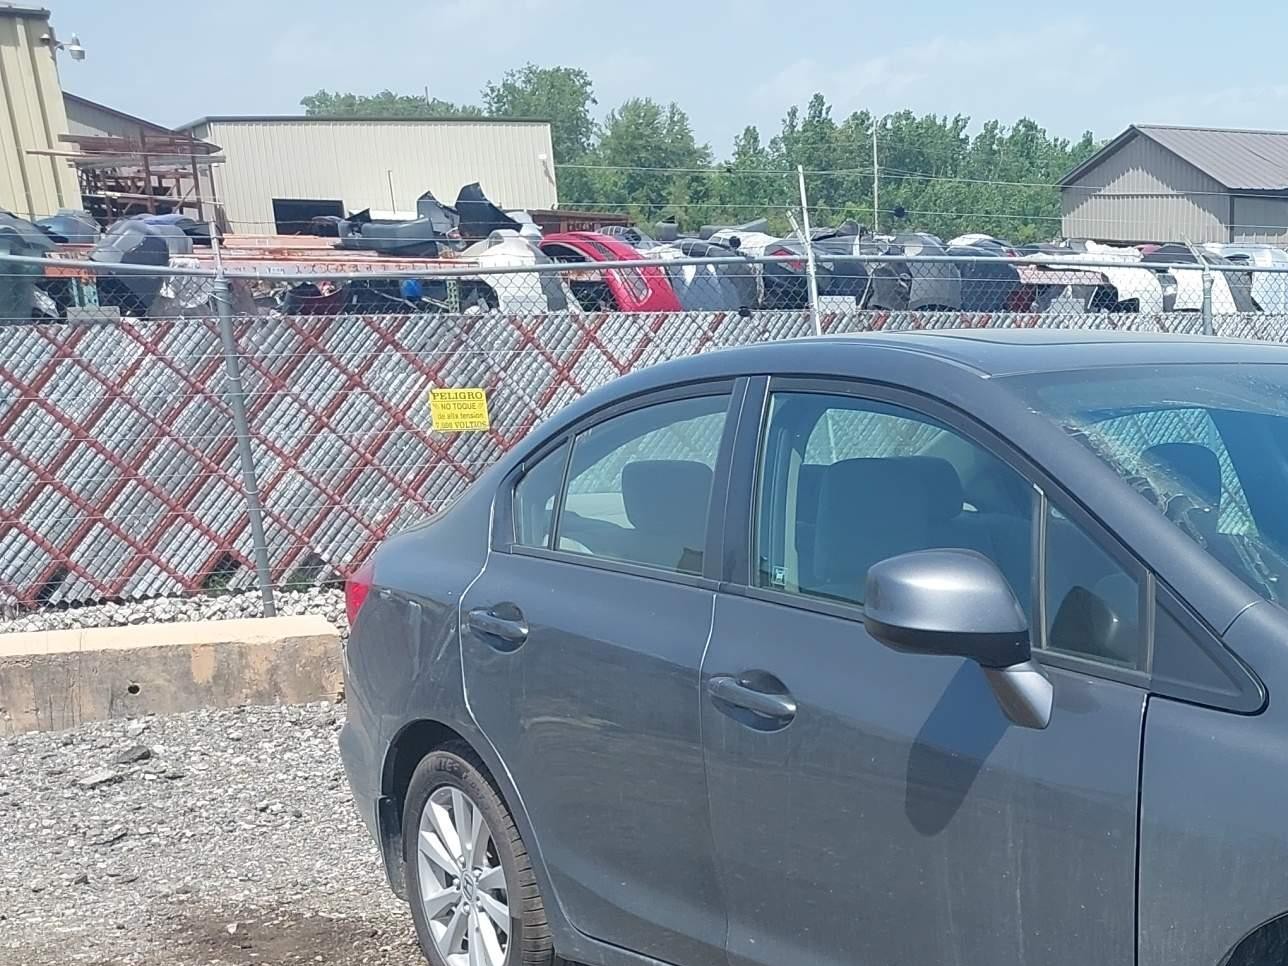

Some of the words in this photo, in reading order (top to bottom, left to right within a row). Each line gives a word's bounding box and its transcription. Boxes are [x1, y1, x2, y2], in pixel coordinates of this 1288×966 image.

[432, 391, 483, 400] PELIGRO
[440, 402, 451, 410] NO
[452, 402, 477, 410] TOQUE
